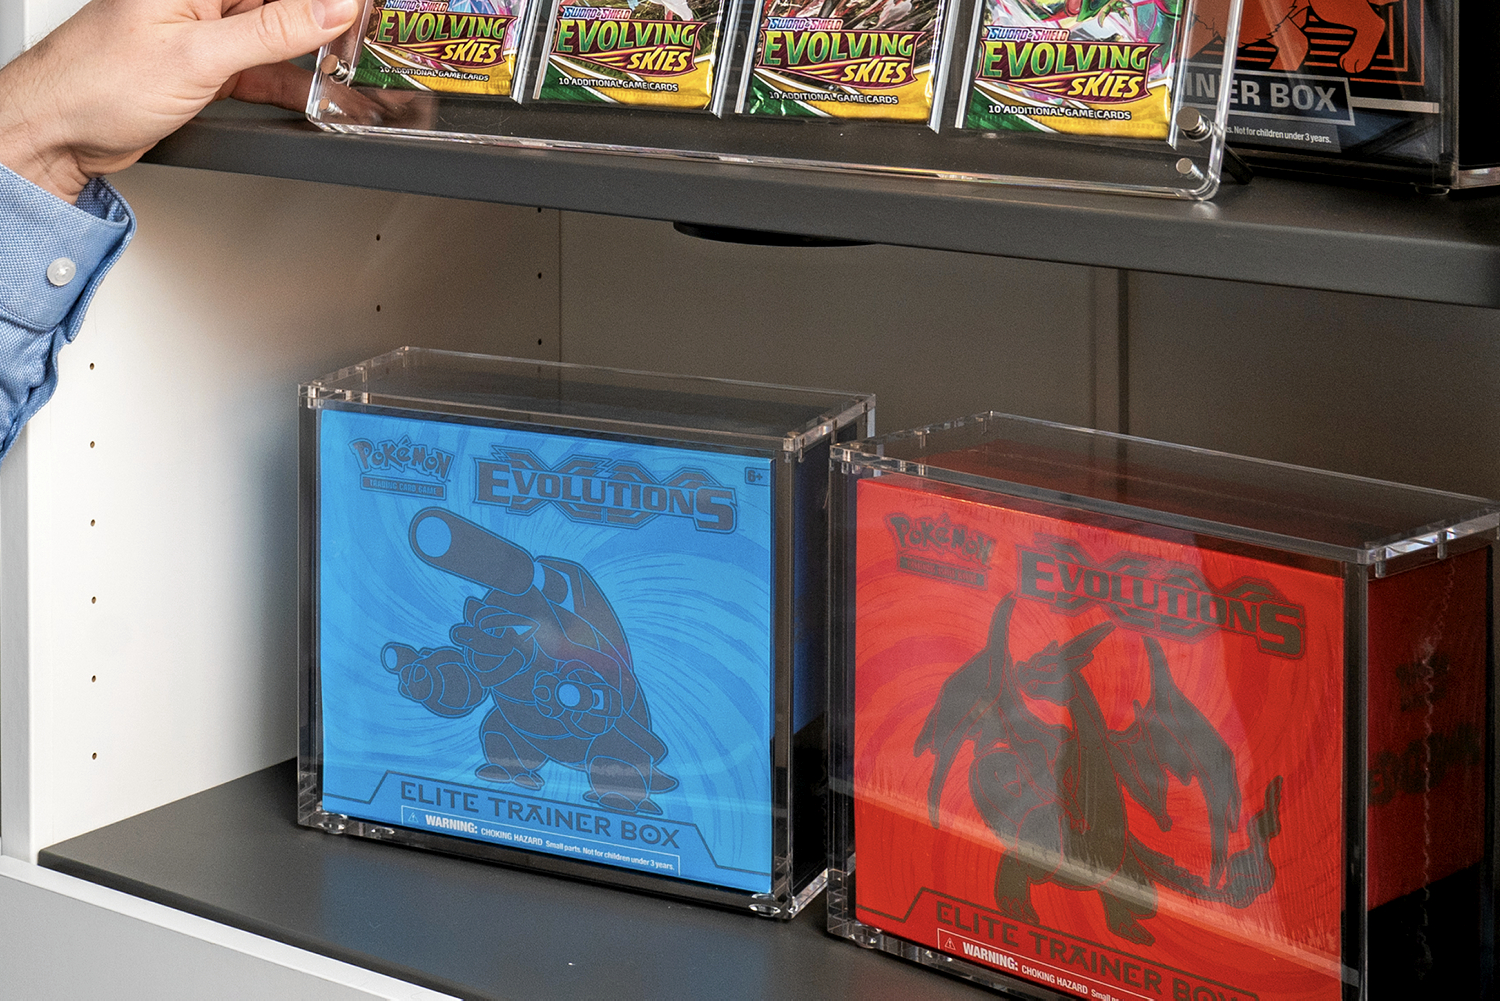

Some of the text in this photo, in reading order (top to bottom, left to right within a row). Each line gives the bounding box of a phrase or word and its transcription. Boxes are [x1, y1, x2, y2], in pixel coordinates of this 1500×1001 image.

[376, 10, 507, 43] EVOLVING
[557, 19, 697, 53] EVOLVING
[440, 39, 503, 64] SKIES
[627, 47, 692, 72] SKIES
[763, 30, 914, 66] EVOLVING
[981, 41, 1148, 78] EVOLVING
[391, 67, 436, 77] ADDITIONAL
[438, 70, 462, 80] GAME
[463, 72, 489, 82] CARDS
[572, 78, 620, 88] ADDITIONAL
[622, 81, 648, 90] GAME
[649, 82, 678, 92] CARDS
[840, 59, 910, 84] SKIES
[1067, 72, 1145, 98] SKIES
[769, 91, 898, 104] 10 ADDITIONAL GAME CARDS
[1269, 83, 1337, 112] BOX
[988, 105, 1131, 120] 10 ADDITIONAL GAME CARDS
[1233, 126, 1246, 135] Not
[1246, 127, 1256, 136] for
[1256, 128, 1284, 139] children
[1284, 131, 1304, 141] under
[1310, 133, 1332, 144] years.
[369, 479, 437, 496] TRADING CARD GAME
[747, 471, 763, 482] 6+
[476, 460, 736, 532] EVOLUTIONS
[1021, 550, 1304, 658] EVOLUTIONS
[401, 781, 680, 849] ELITE TRAINER BOX
[425, 814, 478, 834] WARNING:
[481, 828, 512, 841] CHOKING
[513, 833, 543, 846] HAZARD
[545, 840, 564, 850] Small
[564, 844, 582, 854] parts.
[582, 847, 595, 856] Not
[595, 848, 603, 857] for
[604, 851, 630, 863] children
[630, 856, 650, 866] under
[655, 861, 675, 871] years.
[936, 901, 1019, 948] ELITE
[1028, 930, 1163, 996] TRAINER
[963, 941, 1019, 972] WARNING:
[1021, 964, 1055, 984] CHOKING
[1056, 976, 1089, 995] HAZARD
